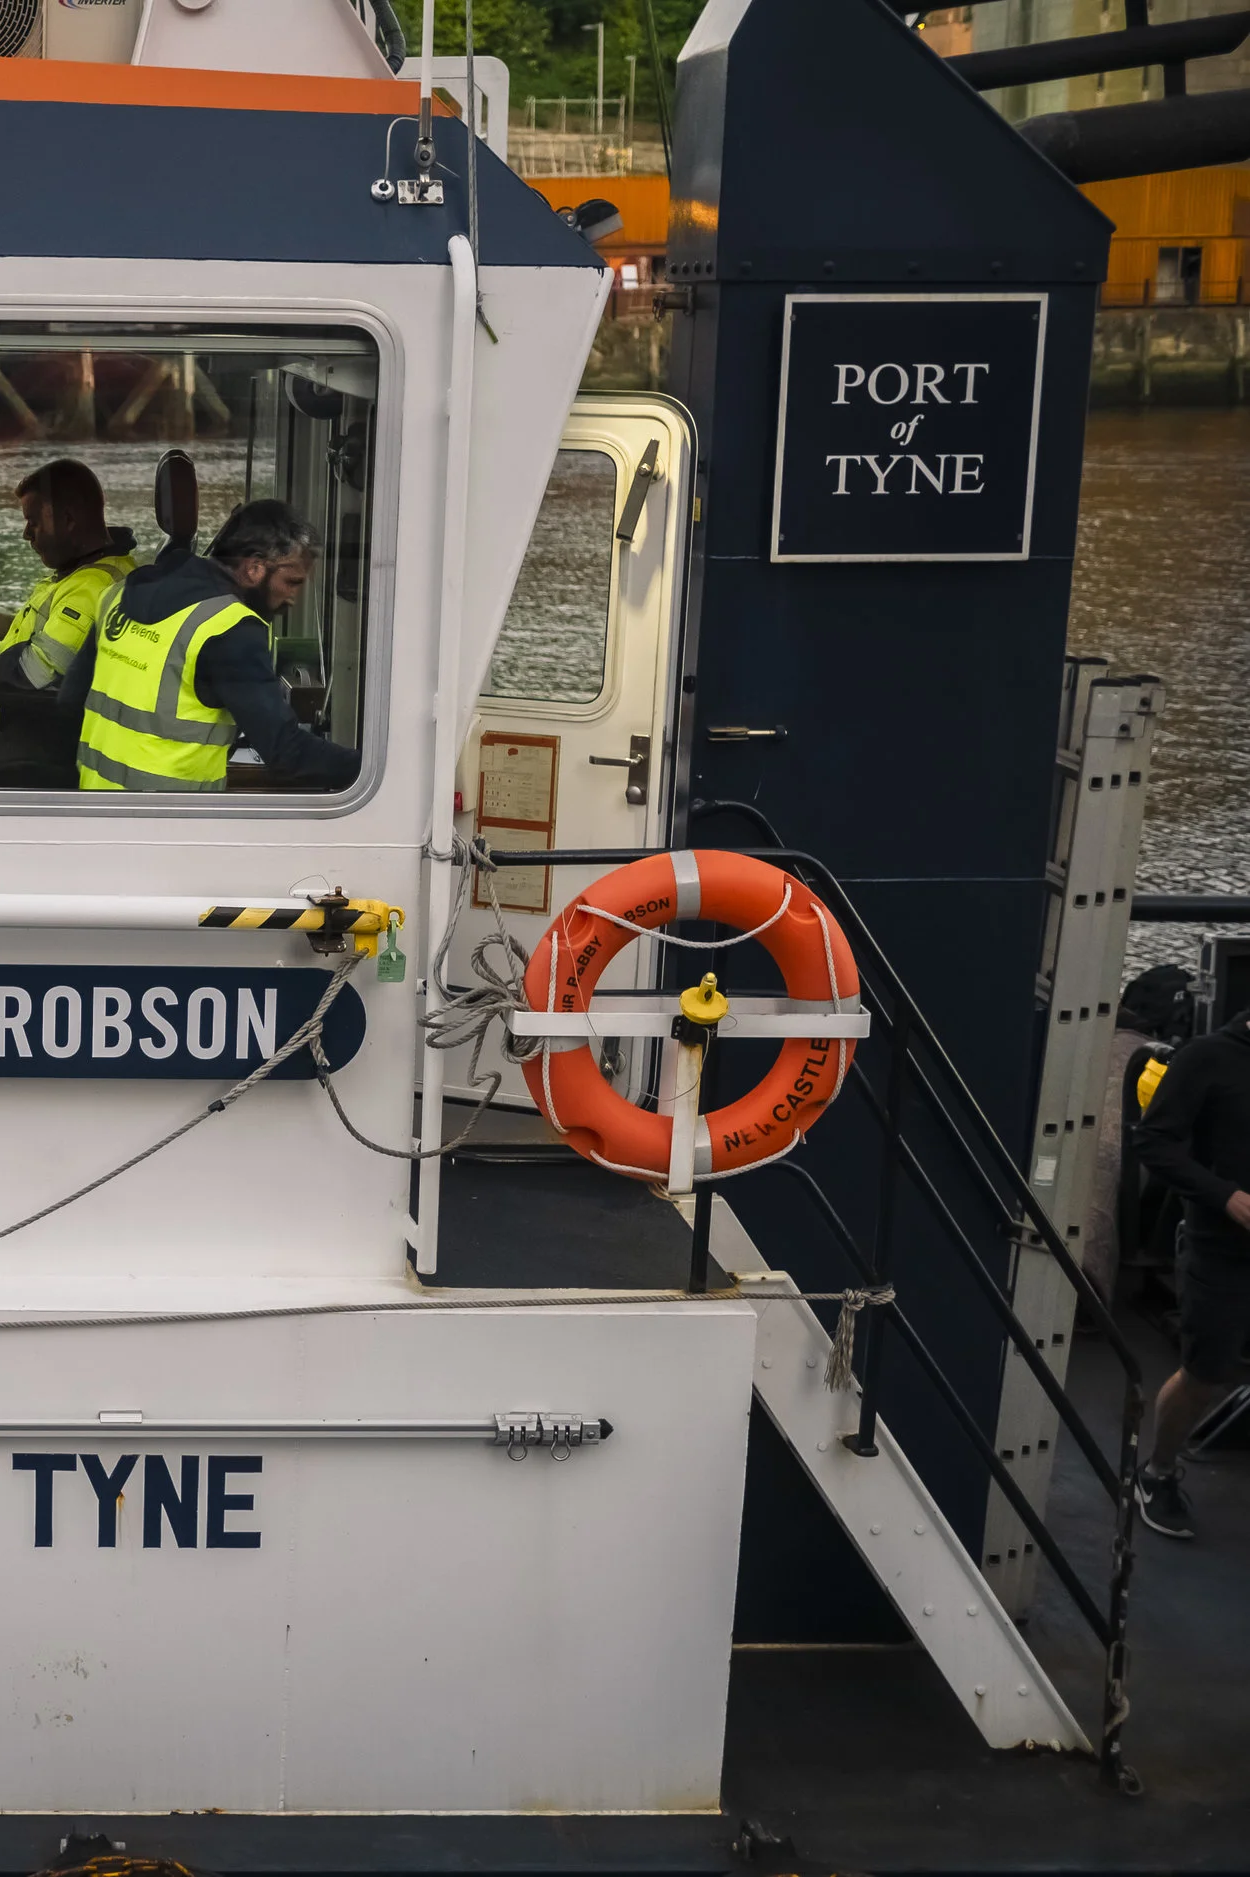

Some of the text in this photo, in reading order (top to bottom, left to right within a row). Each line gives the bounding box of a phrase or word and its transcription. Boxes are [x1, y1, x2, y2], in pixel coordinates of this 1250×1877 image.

[831, 363, 990, 405] PORT
[890, 414, 925, 446] of
[825, 454, 985, 495] TYNE
[130, 623, 160, 643] events
[12, 1453, 263, 1549] TYNE
